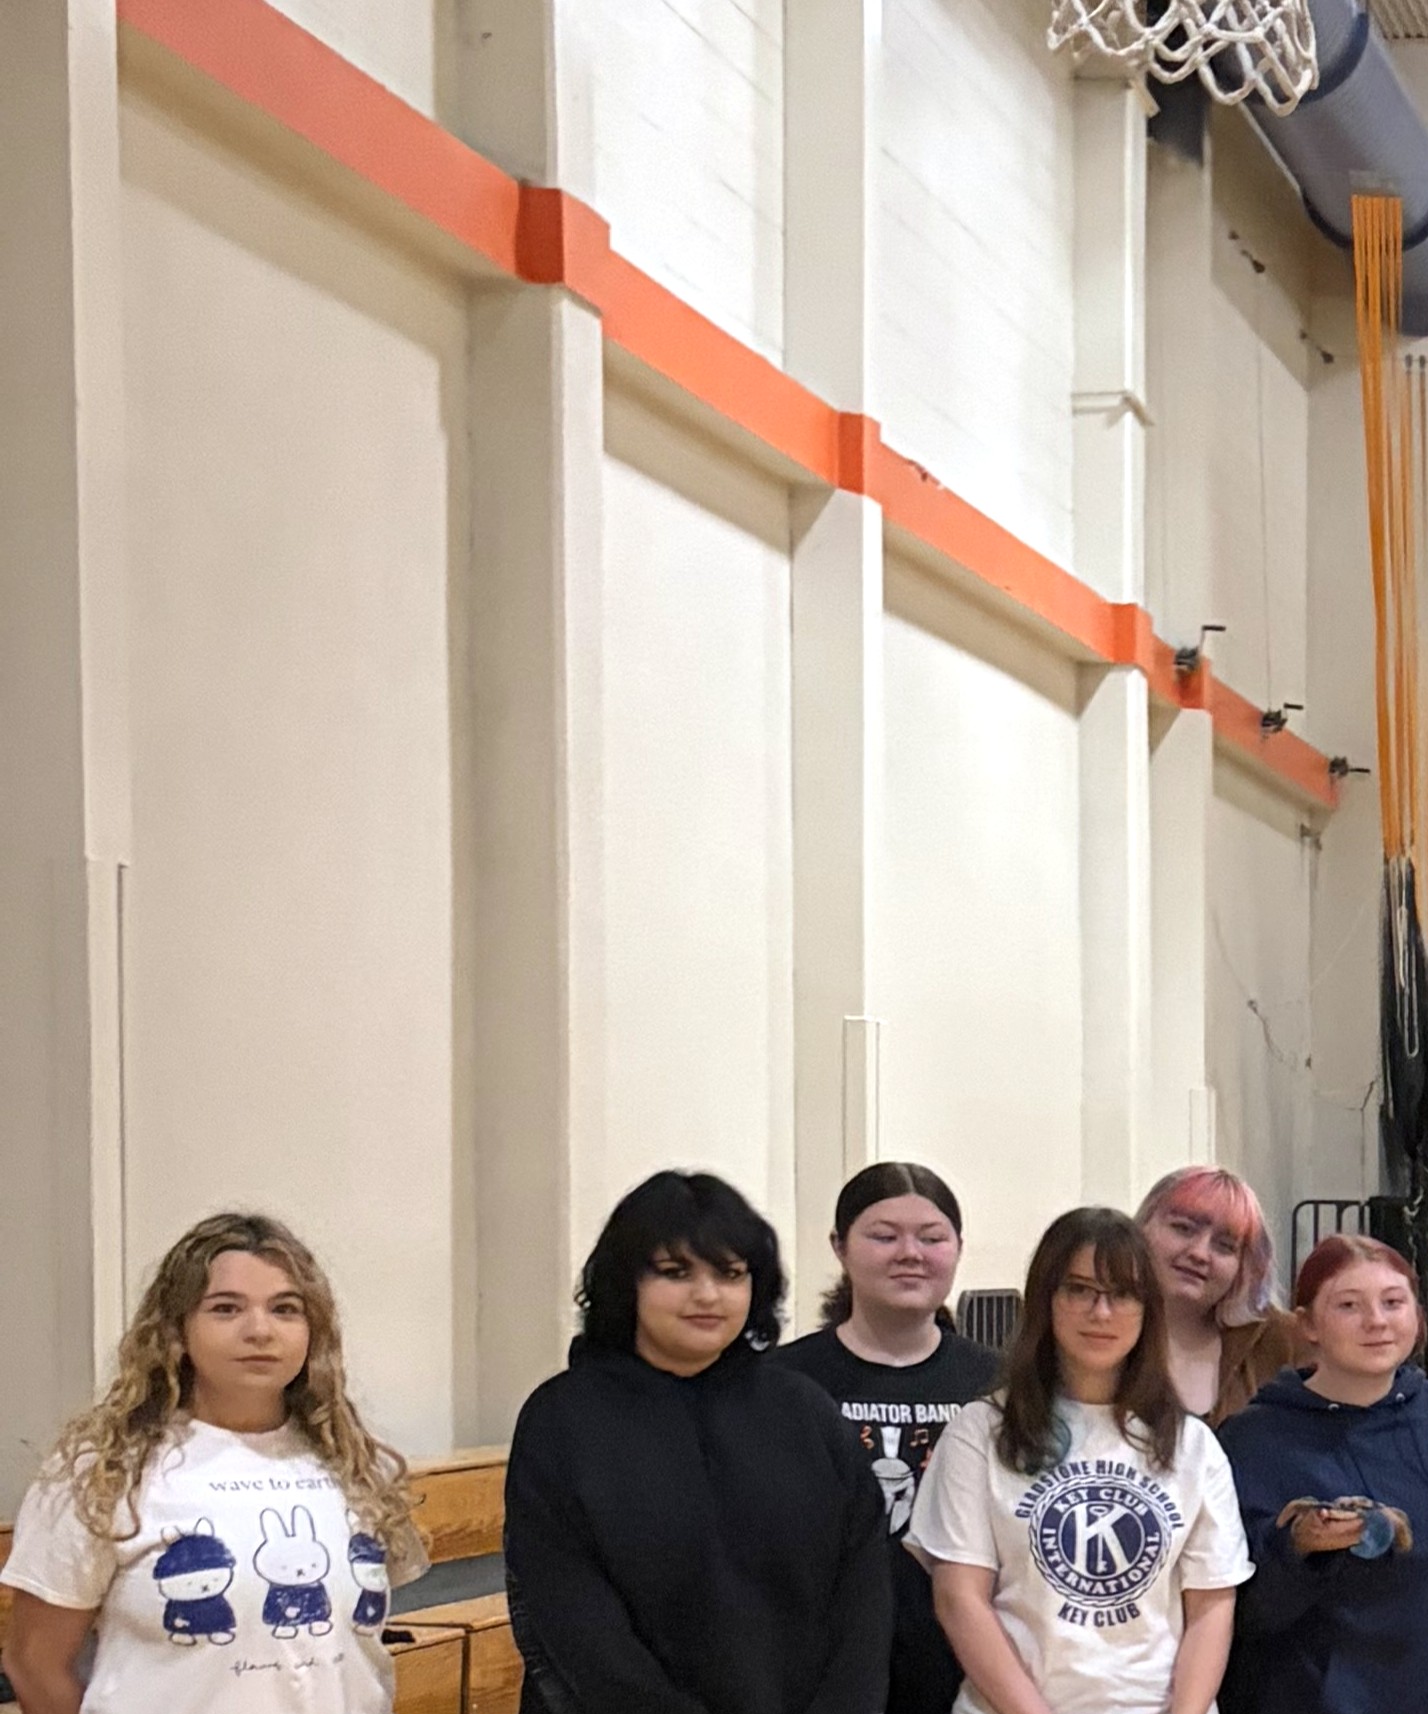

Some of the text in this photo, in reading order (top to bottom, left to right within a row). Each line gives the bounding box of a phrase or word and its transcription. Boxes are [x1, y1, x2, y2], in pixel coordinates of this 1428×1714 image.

[841, 1402, 912, 1424] ADIATOR
[209, 1479, 263, 1492] wave
[269, 1477, 290, 1491] to
[1015, 1460, 1185, 1529] GLADSTONE HIGH SCHOOL
[1053, 1488, 1149, 1517] KEY CLUB
[1042, 1528, 1160, 1594] INTERNATIONAL
[1058, 1602, 1141, 1628] KEY CLUB
